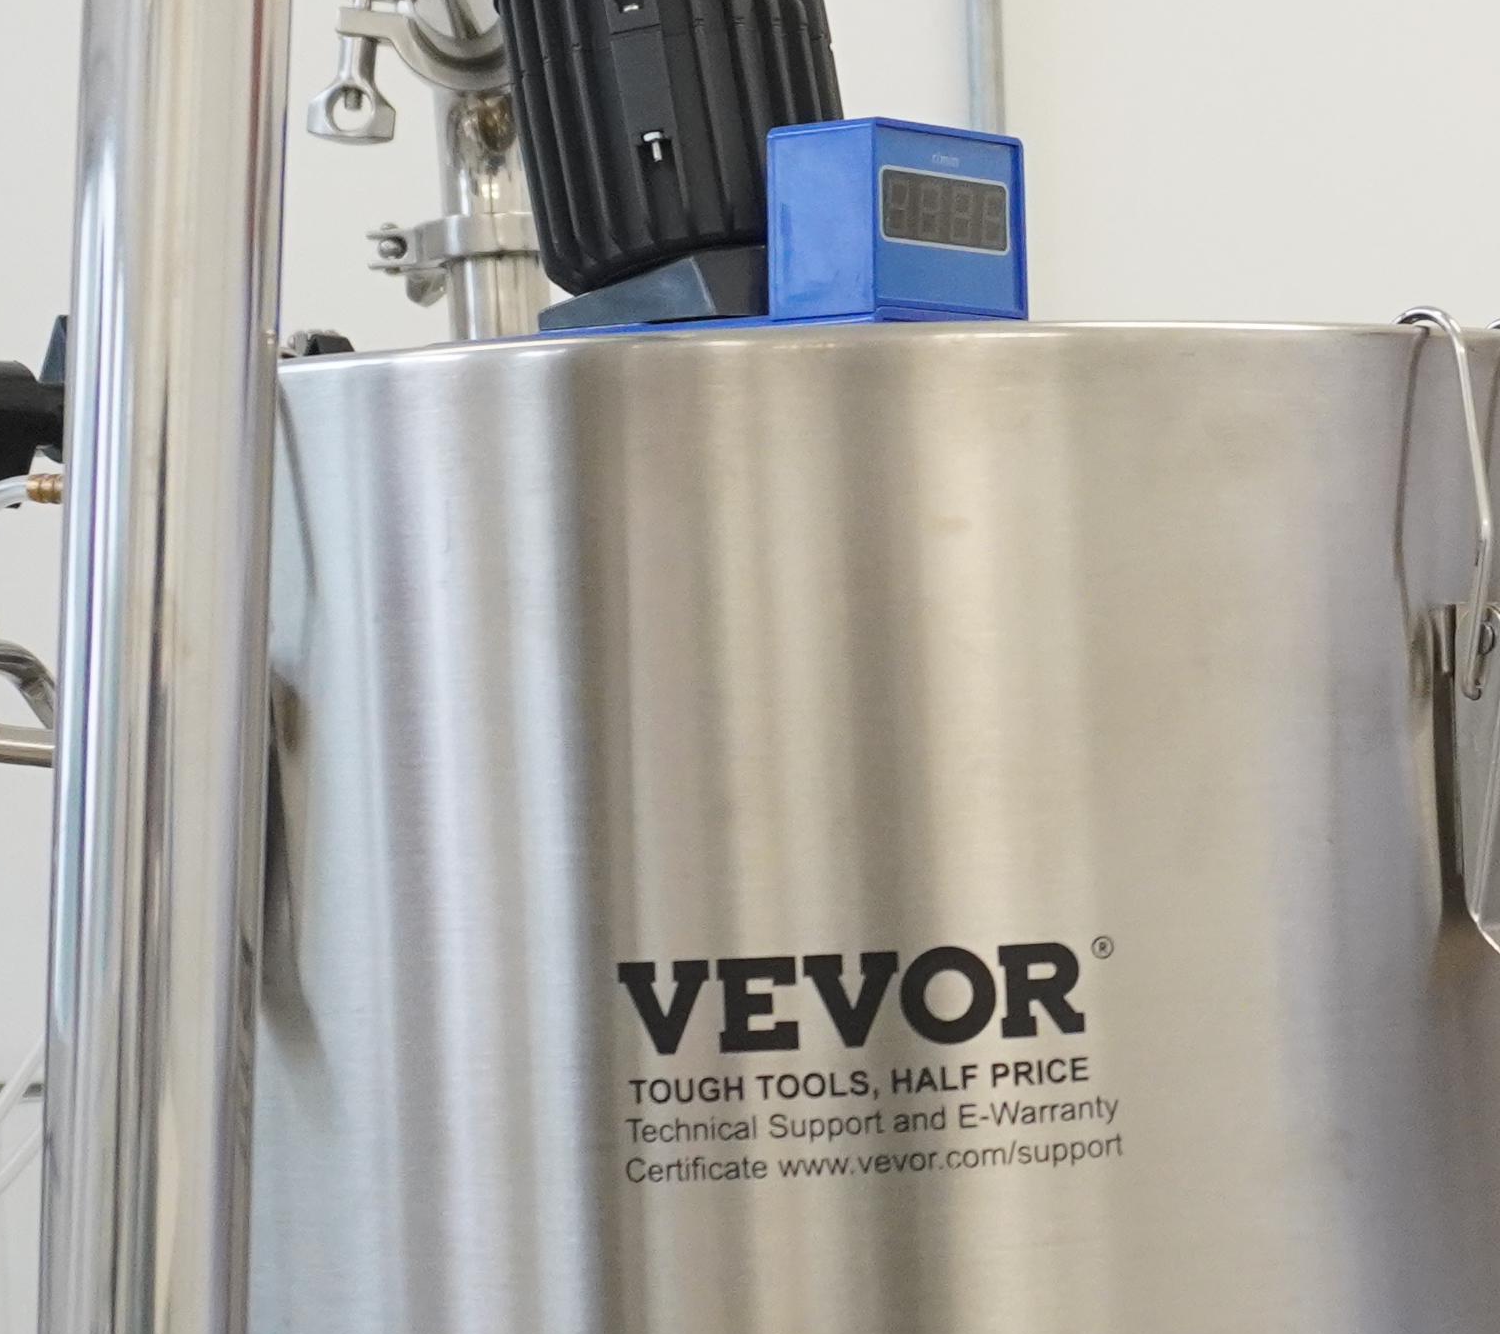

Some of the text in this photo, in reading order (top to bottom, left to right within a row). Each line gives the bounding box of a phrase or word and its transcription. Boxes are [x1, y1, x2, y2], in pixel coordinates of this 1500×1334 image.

[628, 1056, 1090, 1105] TOUGH TOOLS, HALF PRICE
[625, 1095, 1119, 1143] Technical Support and E-Warranty
[625, 1132, 1124, 1184] Certificate www.vevor.com/support
